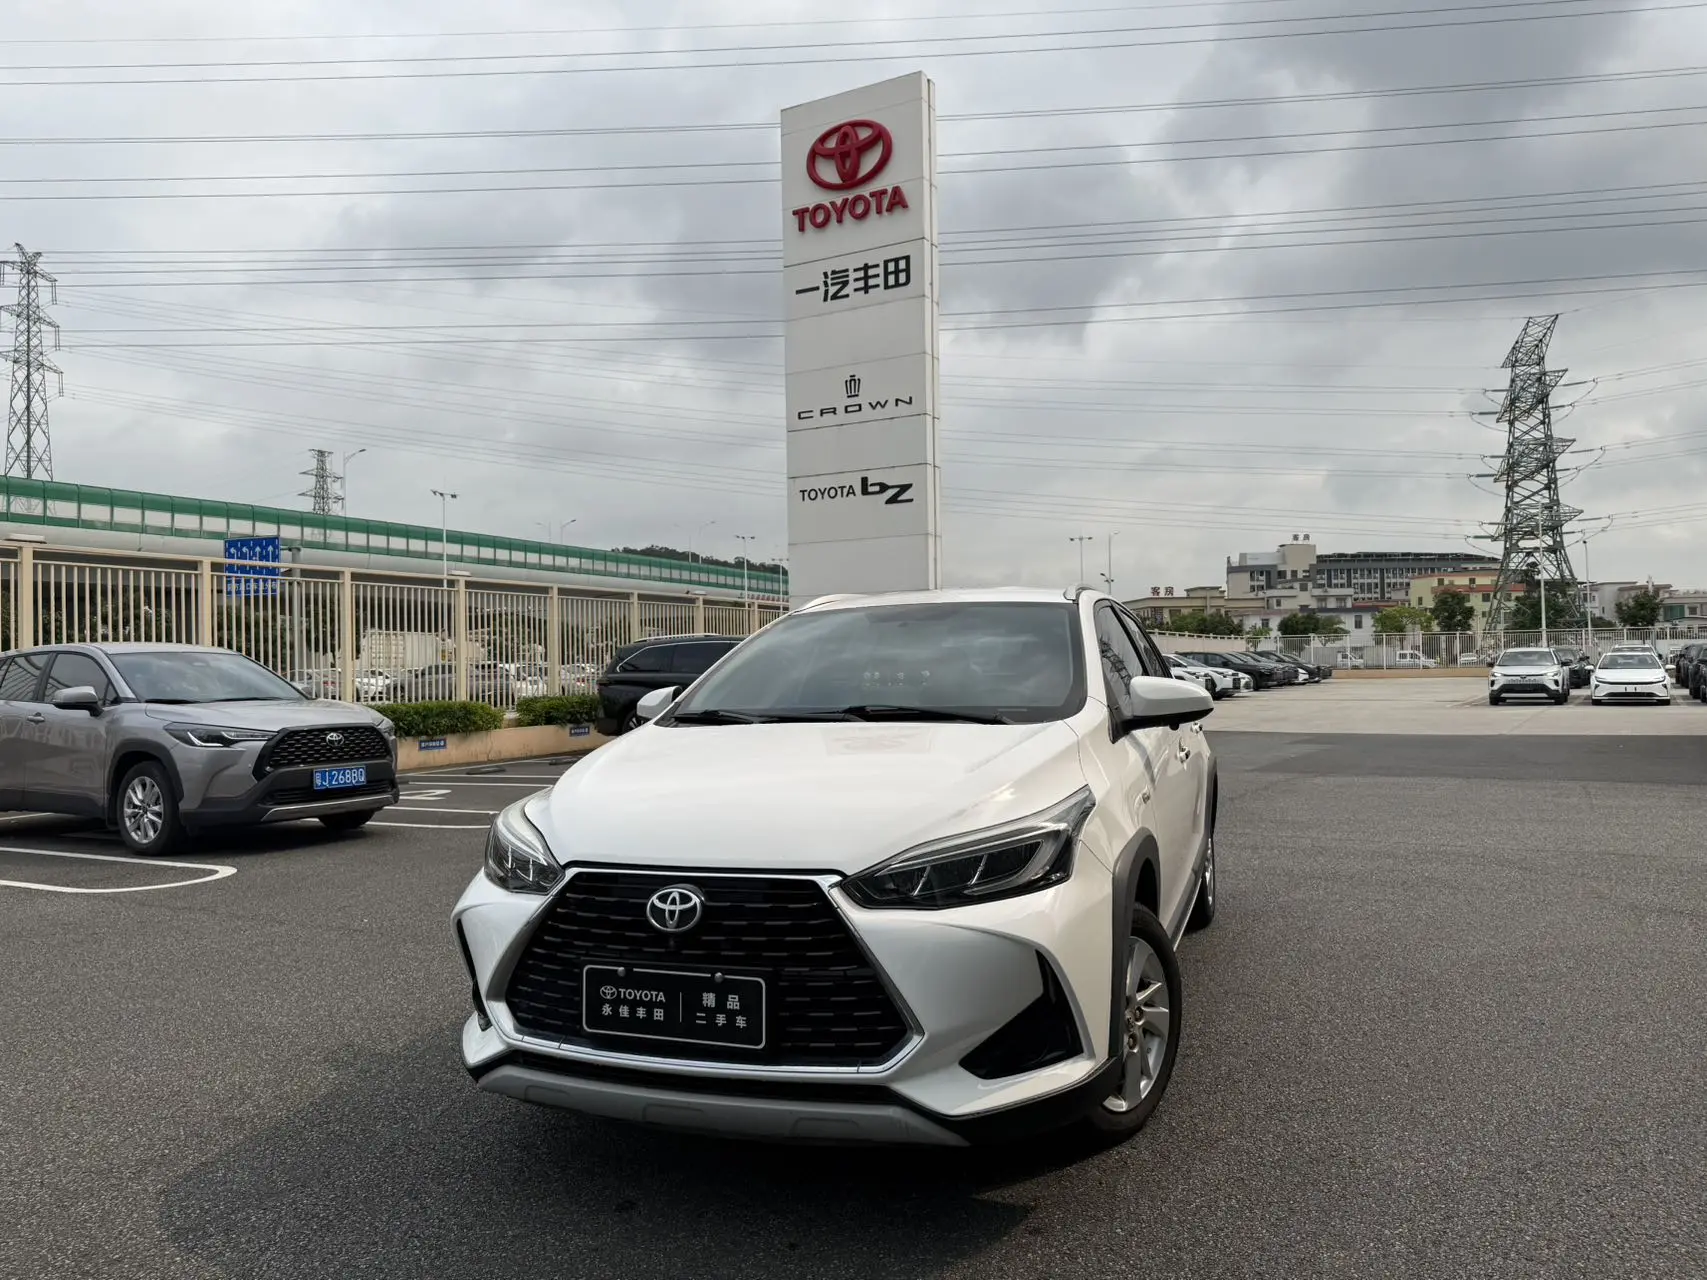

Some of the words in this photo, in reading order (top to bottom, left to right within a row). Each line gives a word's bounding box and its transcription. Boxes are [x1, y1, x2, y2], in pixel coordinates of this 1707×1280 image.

[793, 186, 908, 232] TOYOTA
[795, 255, 911, 302] 一汽丰田
[798, 396, 913, 420] CROWN
[799, 484, 857, 502] TOYOTA
[1150, 586, 1174, 597] 客房
[619, 988, 666, 1003] TOYOTA
[702, 992, 740, 1010] 精品
[602, 1003, 664, 1021] 永佳丰田
[696, 1012, 747, 1029] 二手车
